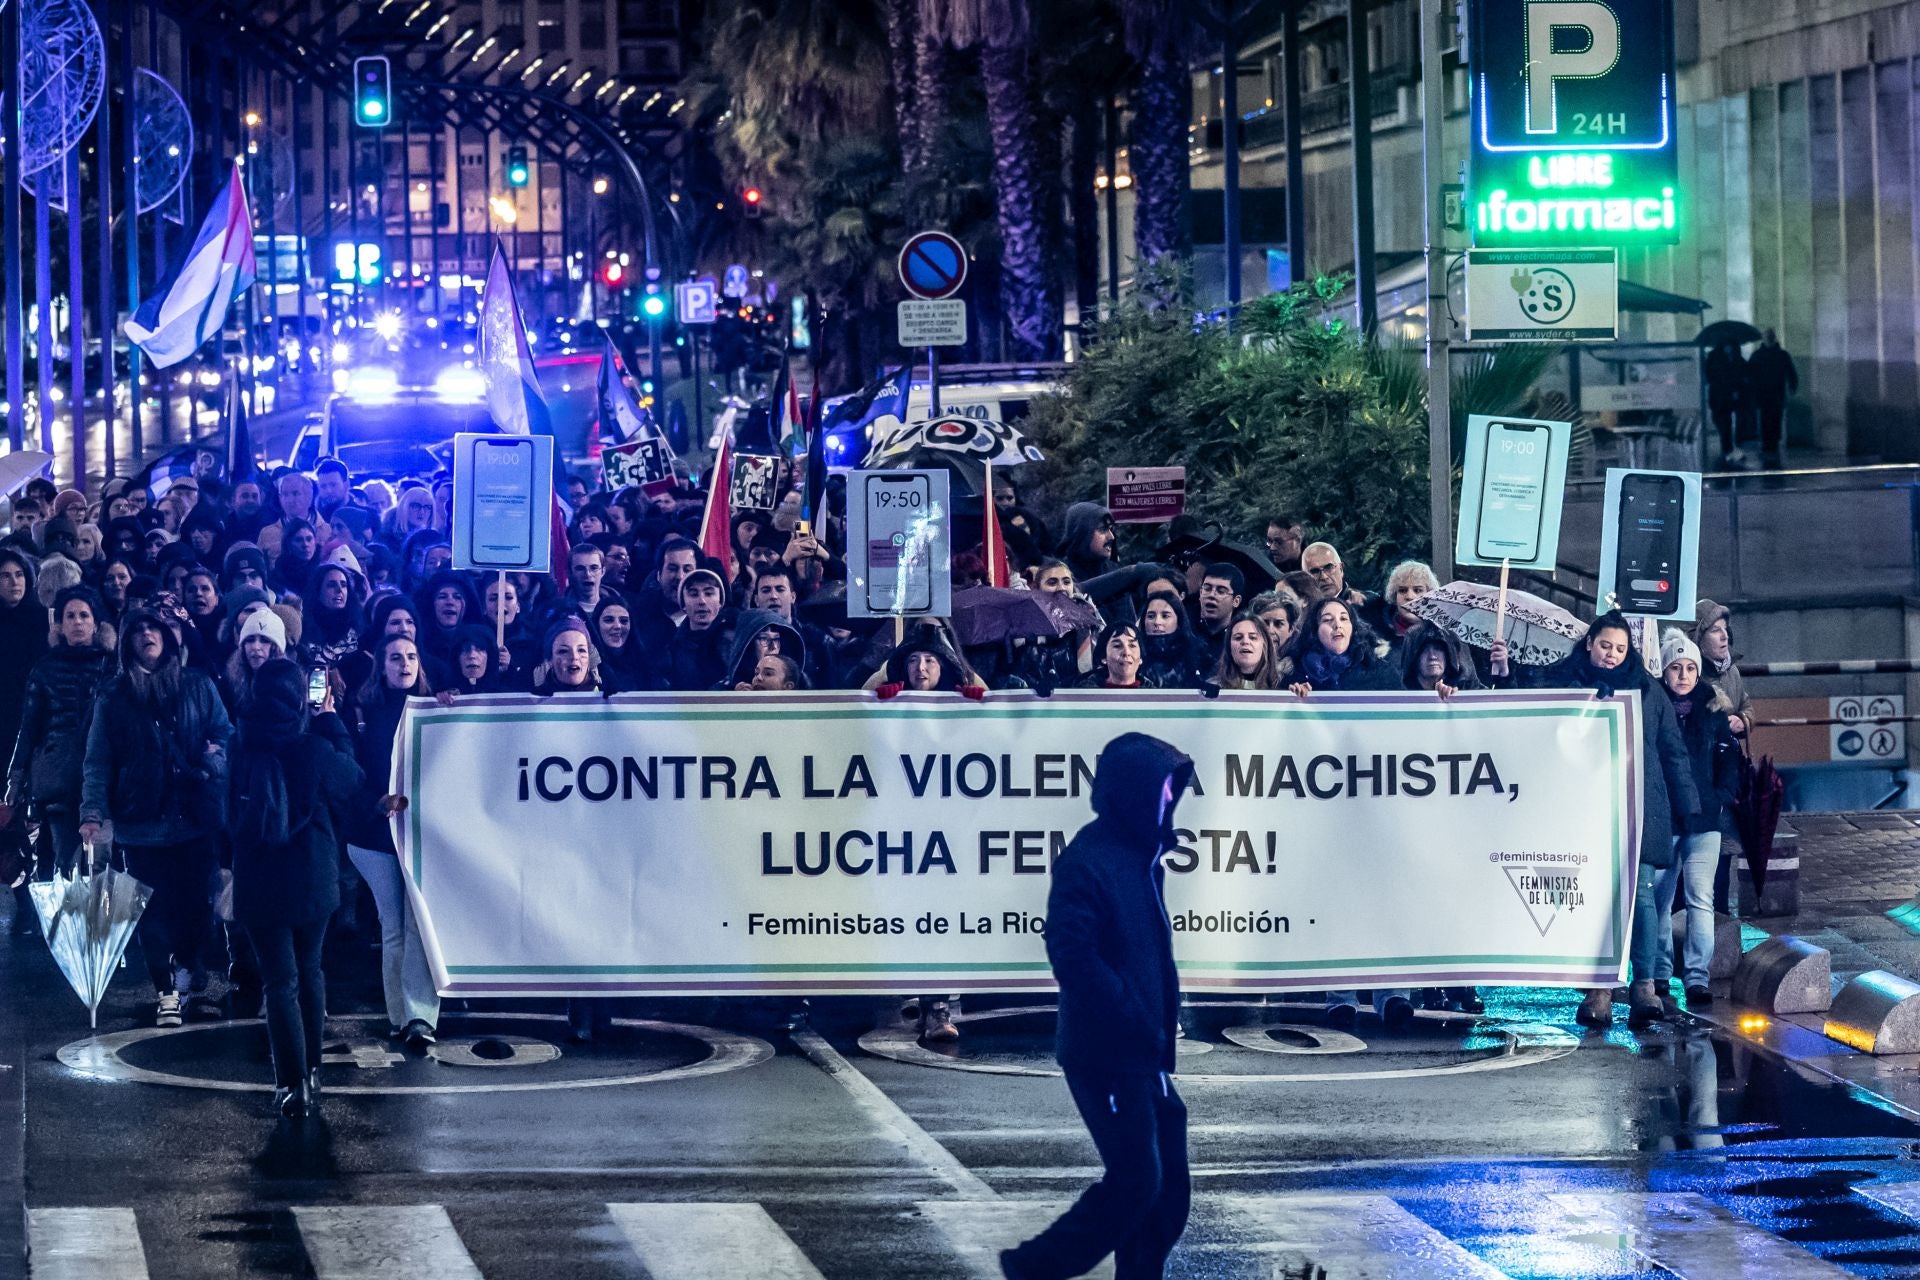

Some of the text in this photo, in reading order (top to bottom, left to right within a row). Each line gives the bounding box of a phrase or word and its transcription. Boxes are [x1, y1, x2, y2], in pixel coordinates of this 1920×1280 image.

[1523, 0, 1621, 134] P
[1572, 112, 1627, 135] 24H
[1530, 154, 1613, 188] LIBRE
[1488, 252, 1596, 261] www.electromaps.com
[686, 287, 707, 319] P
[1508, 330, 1577, 340] www.syder.es
[1501, 440, 1535, 455] 19:00
[486, 453, 520, 465] 19:00
[875, 491, 920, 508] 19:50
[519, 755, 781, 801] ¡CONTRA
[804, 754, 879, 798] LA
[1226, 753, 1519, 802] MACHISTA,
[763, 829, 957, 876] LUCHA
[1490, 851, 1588, 865] @feministasrioja
[1520, 876, 1579, 891] FEMINISTAS
[1529, 891, 1585, 908] DE LA RIOJA
[748, 912, 905, 936] Feministas
[916, 911, 949, 935] de
[961, 911, 992, 935] La
[1172, 909, 1290, 933] abolición
